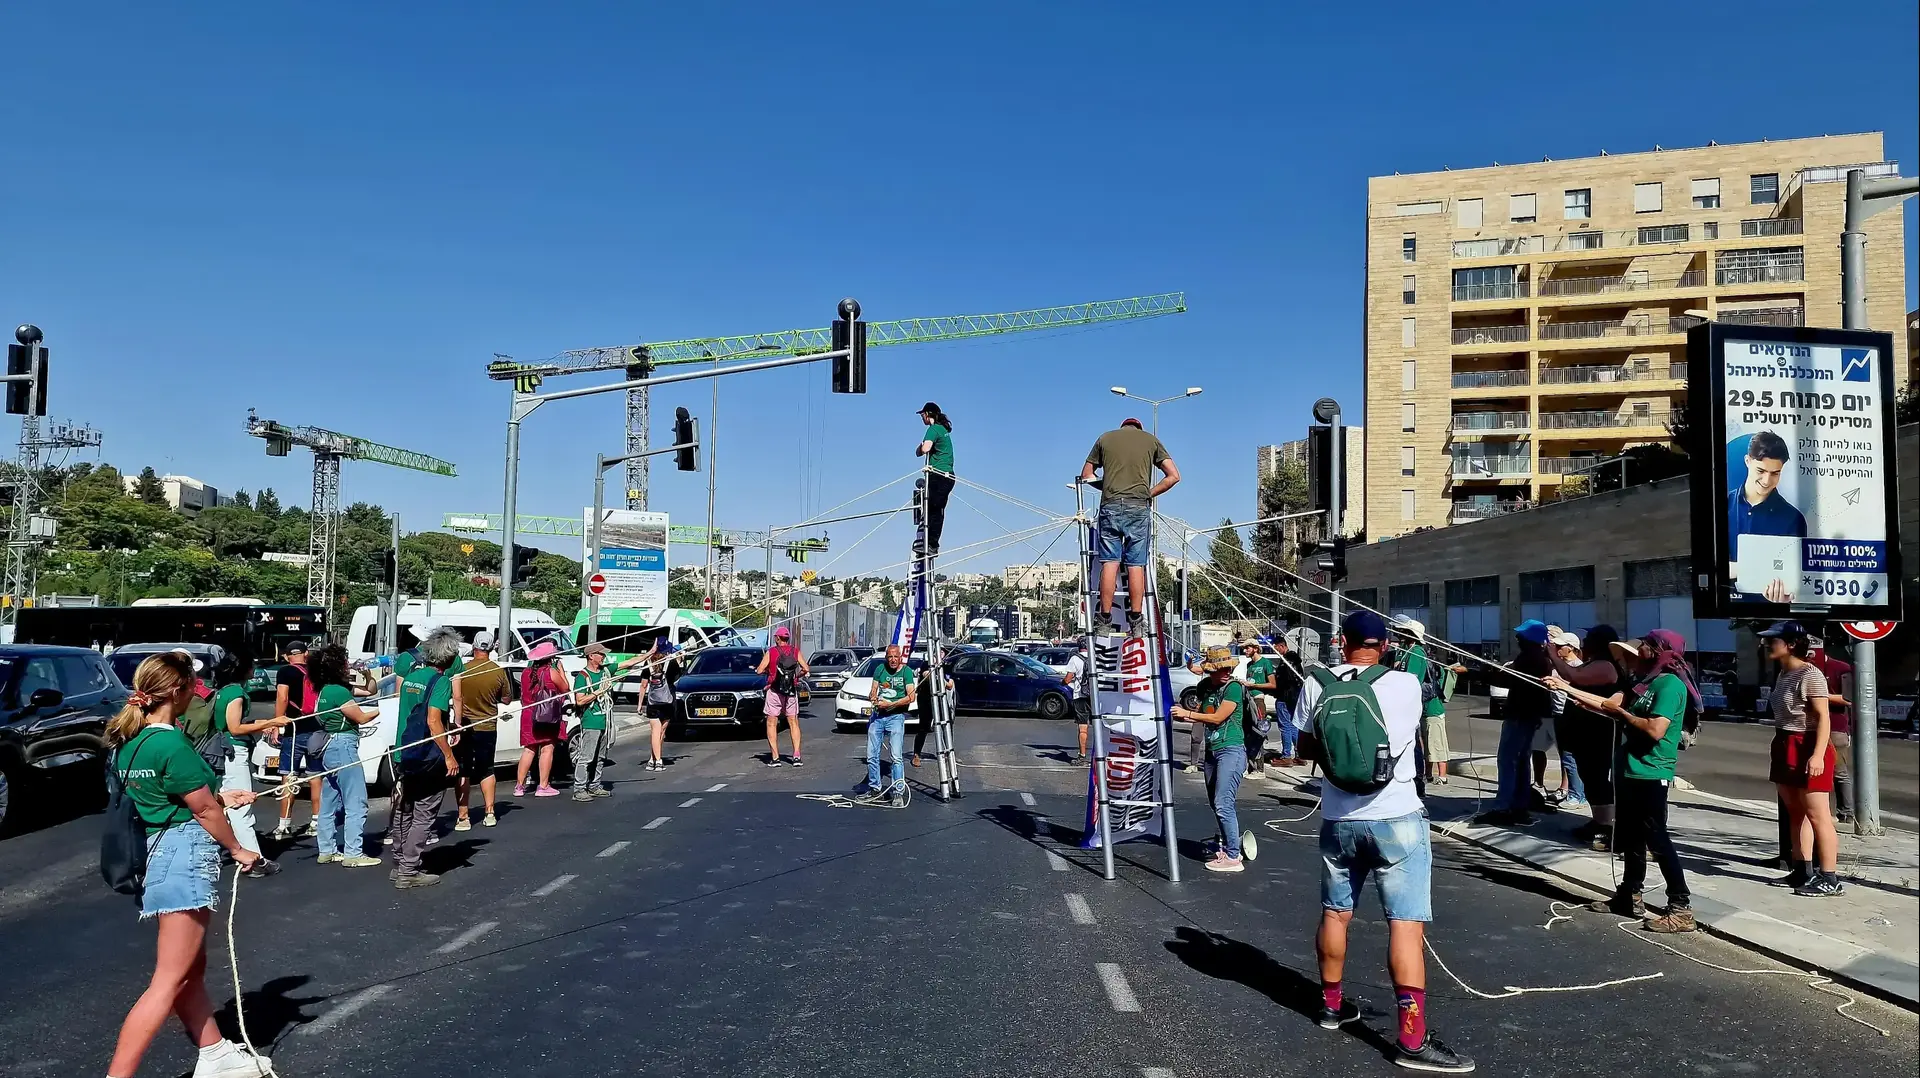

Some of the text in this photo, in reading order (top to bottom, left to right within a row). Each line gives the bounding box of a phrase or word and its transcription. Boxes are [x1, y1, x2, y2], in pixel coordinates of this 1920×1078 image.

[1749, 344, 1811, 358] הנדסאים
[1726, 363, 1834, 381] המכללה למינהל
[1728, 389, 1872, 412] יום פתוח 29.5
[1743, 410, 1873, 430] מסריק 10, ירושלים
[1798, 436, 1873, 451] בואו להיות חלק
[1798, 452, 1873, 465] מהתעשייה, בנייה
[1799, 464, 1873, 479] וההייטק בישראל
[1807, 543, 1877, 559] 100% מימון
[1808, 559, 1878, 569] לחיילים משוחררים
